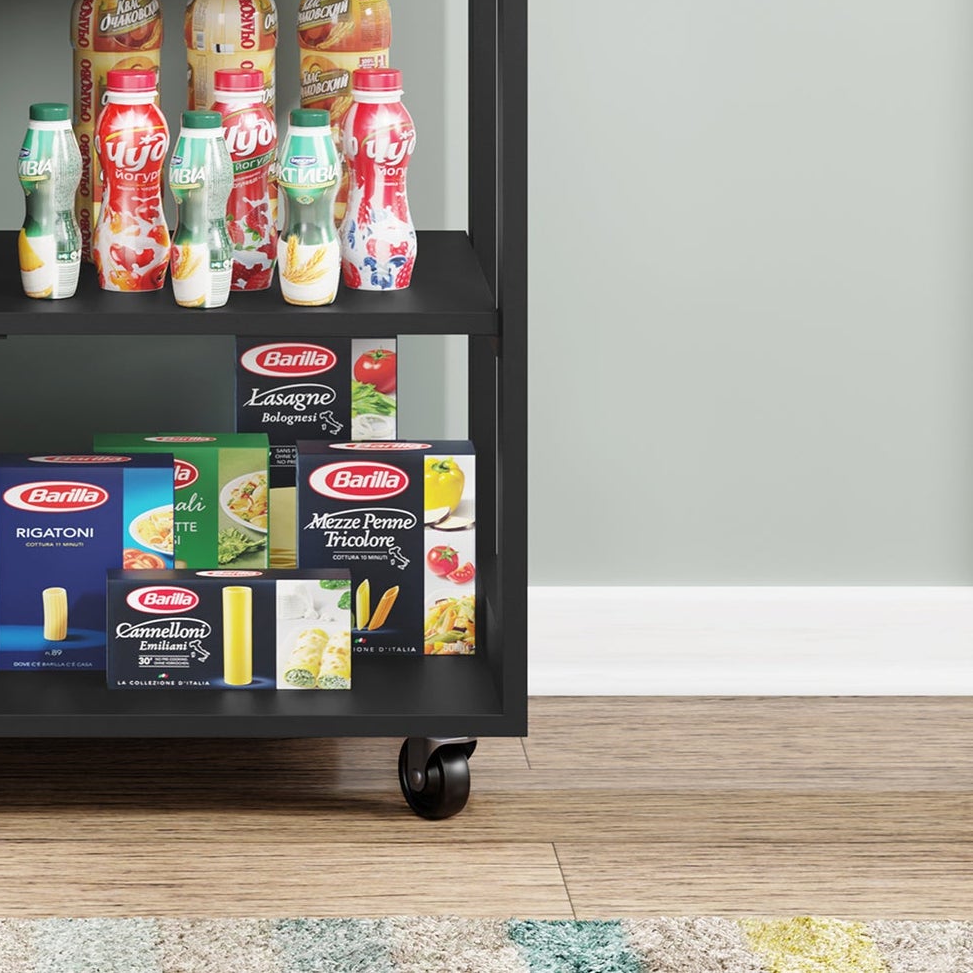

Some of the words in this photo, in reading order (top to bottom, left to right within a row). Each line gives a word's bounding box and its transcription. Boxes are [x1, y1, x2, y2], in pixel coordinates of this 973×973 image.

[263, 351, 329, 367] Barilla
[244, 385, 335, 411] Lasagne
[262, 412, 318, 425] Bolognesi
[331, 471, 401, 488] Barilla
[28, 488, 100, 503] Barilla
[307, 513, 361, 529] Mezze
[363, 513, 414, 530] Penne
[16, 527, 94, 539] RIGATONI
[324, 529, 395, 548] Tricolore
[143, 593, 193, 605] Barilla
[115, 619, 210, 638] Cannelloni
[139, 640, 188, 651] Emiliani
